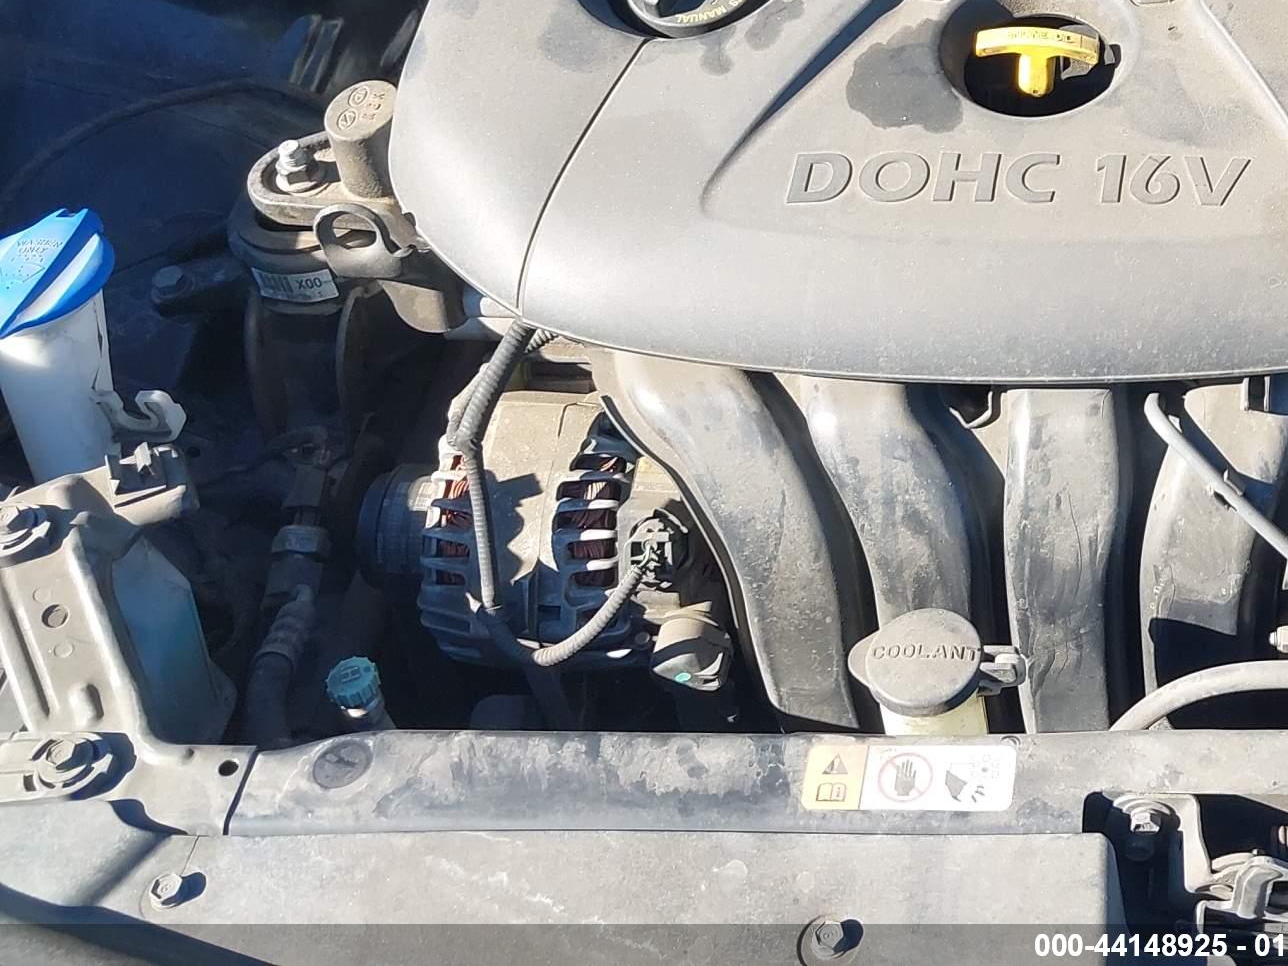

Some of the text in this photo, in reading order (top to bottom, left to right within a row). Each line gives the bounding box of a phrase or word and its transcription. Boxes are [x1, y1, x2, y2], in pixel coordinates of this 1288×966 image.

[676, 3, 728, 24] MANUAL
[786, 152, 1252, 207] DOHC 16V
[872, 643, 981, 662] COOLANT
